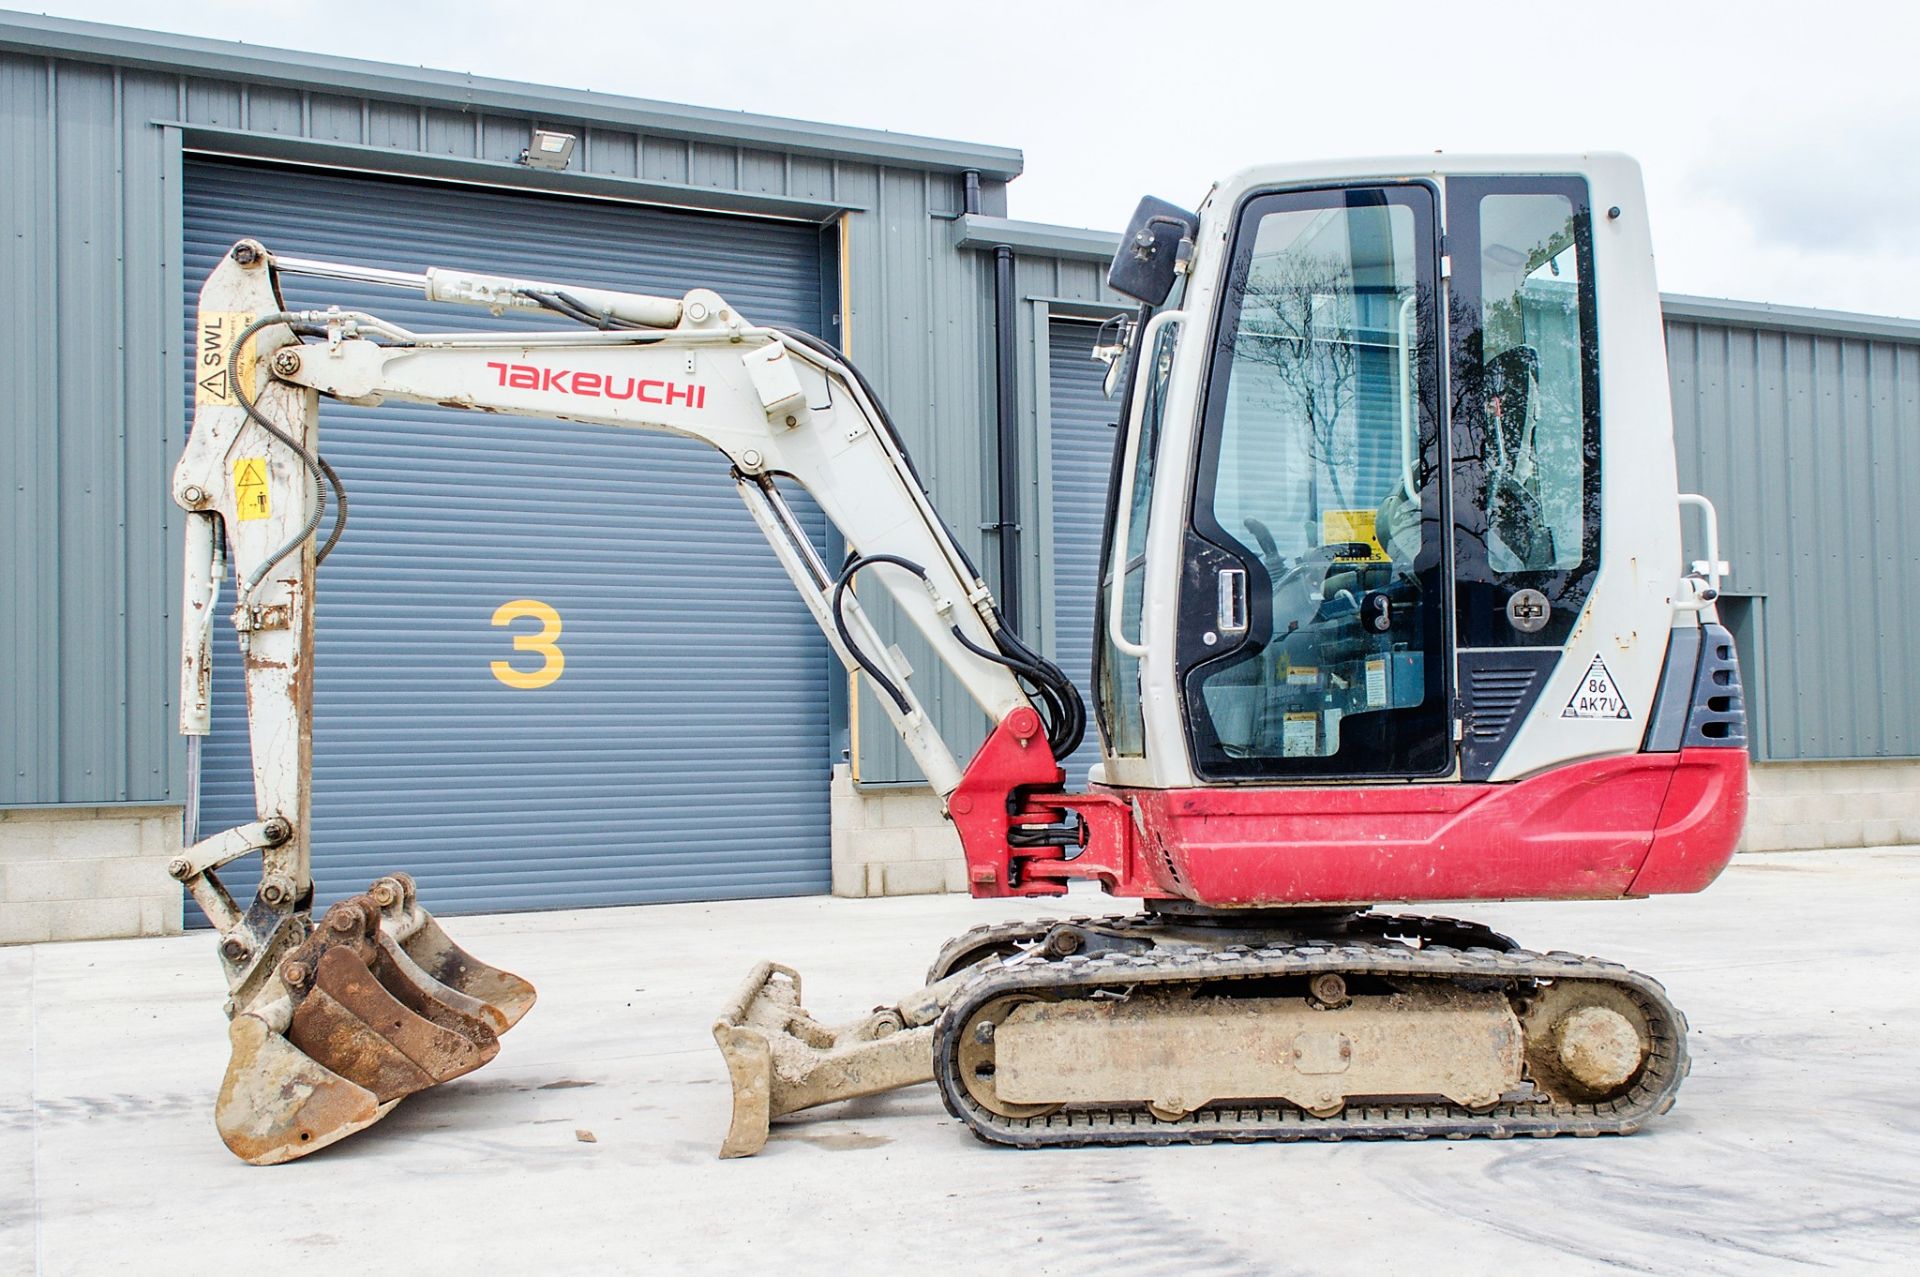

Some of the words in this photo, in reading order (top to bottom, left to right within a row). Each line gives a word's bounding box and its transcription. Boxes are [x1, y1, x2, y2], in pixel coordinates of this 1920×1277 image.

[204, 316, 222, 367] SWL
[487, 361, 705, 409] TAKEUCHI
[489, 599, 565, 690] 3
[1580, 697, 1618, 712] AK7V
[1589, 679, 1607, 693] 86
